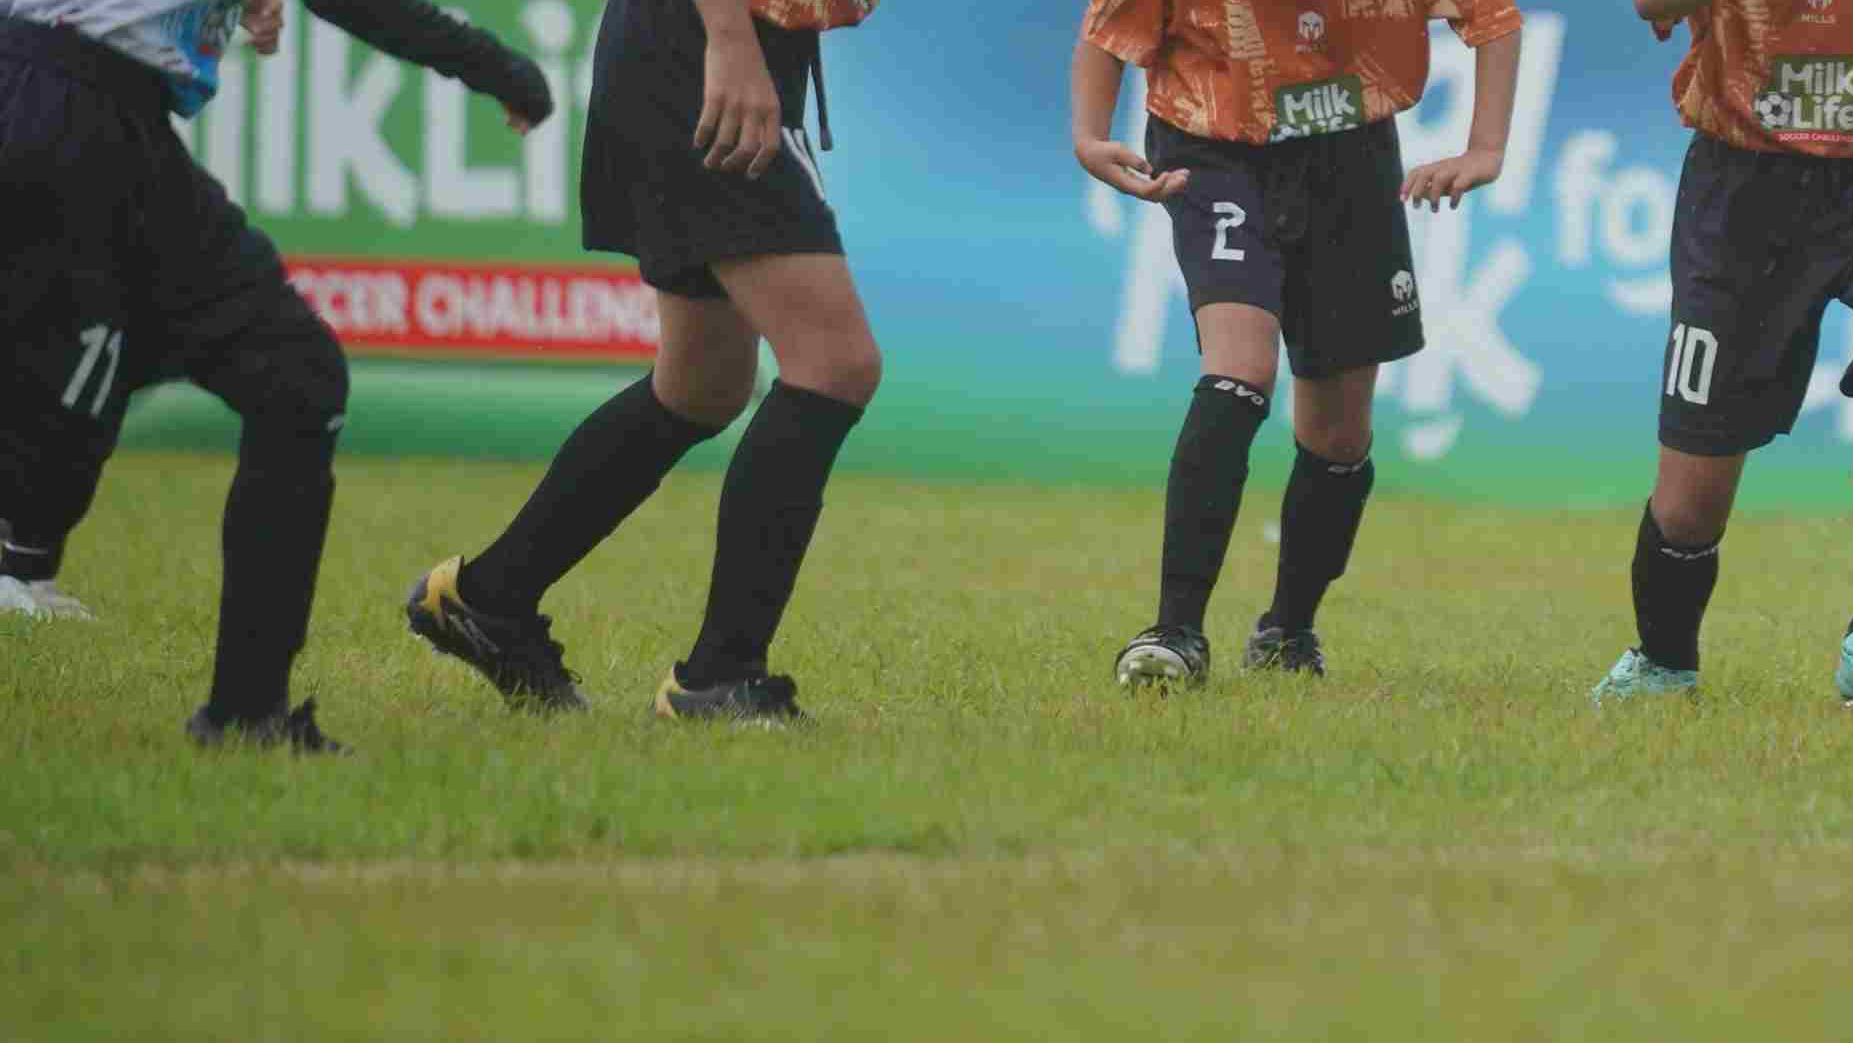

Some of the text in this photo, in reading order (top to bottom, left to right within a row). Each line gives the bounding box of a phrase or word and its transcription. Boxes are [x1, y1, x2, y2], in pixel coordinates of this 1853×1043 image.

[1283, 83, 1356, 124] Milk
[1211, 201, 1247, 261] 2
[61, 323, 124, 419] 11
[1666, 321, 1719, 406] 10
